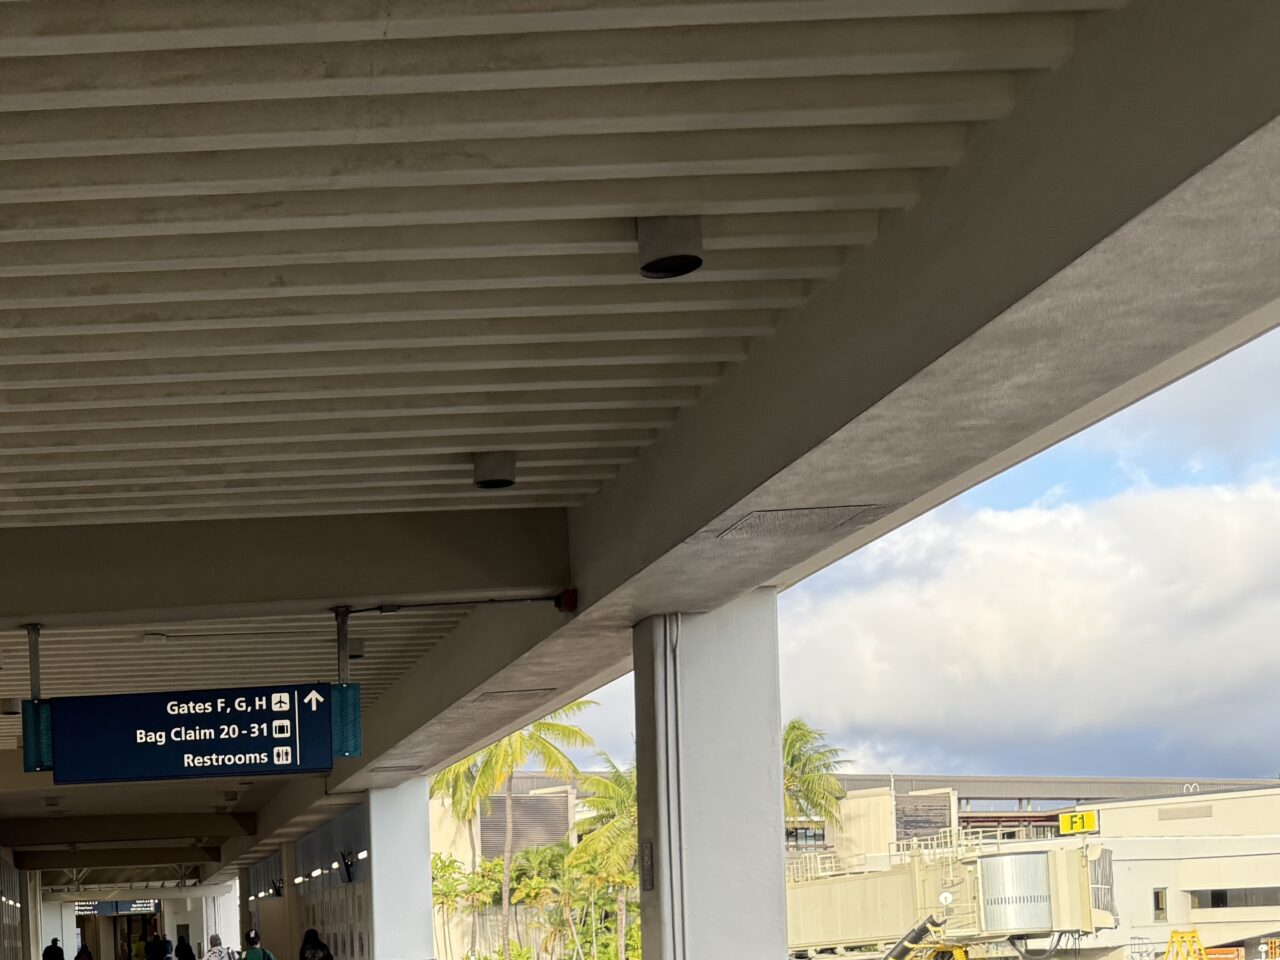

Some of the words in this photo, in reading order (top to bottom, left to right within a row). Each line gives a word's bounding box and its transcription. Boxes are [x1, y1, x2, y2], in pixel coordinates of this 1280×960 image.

[166, 700, 213, 715] Gates
[216, 698, 231, 714] F,
[234, 697, 252, 713] G,
[254, 696, 267, 710] H
[136, 729, 166, 746] Bag
[170, 725, 215, 742] Claim
[183, 752, 269, 768] Restrooms
[1070, 814, 1085, 830] F1
